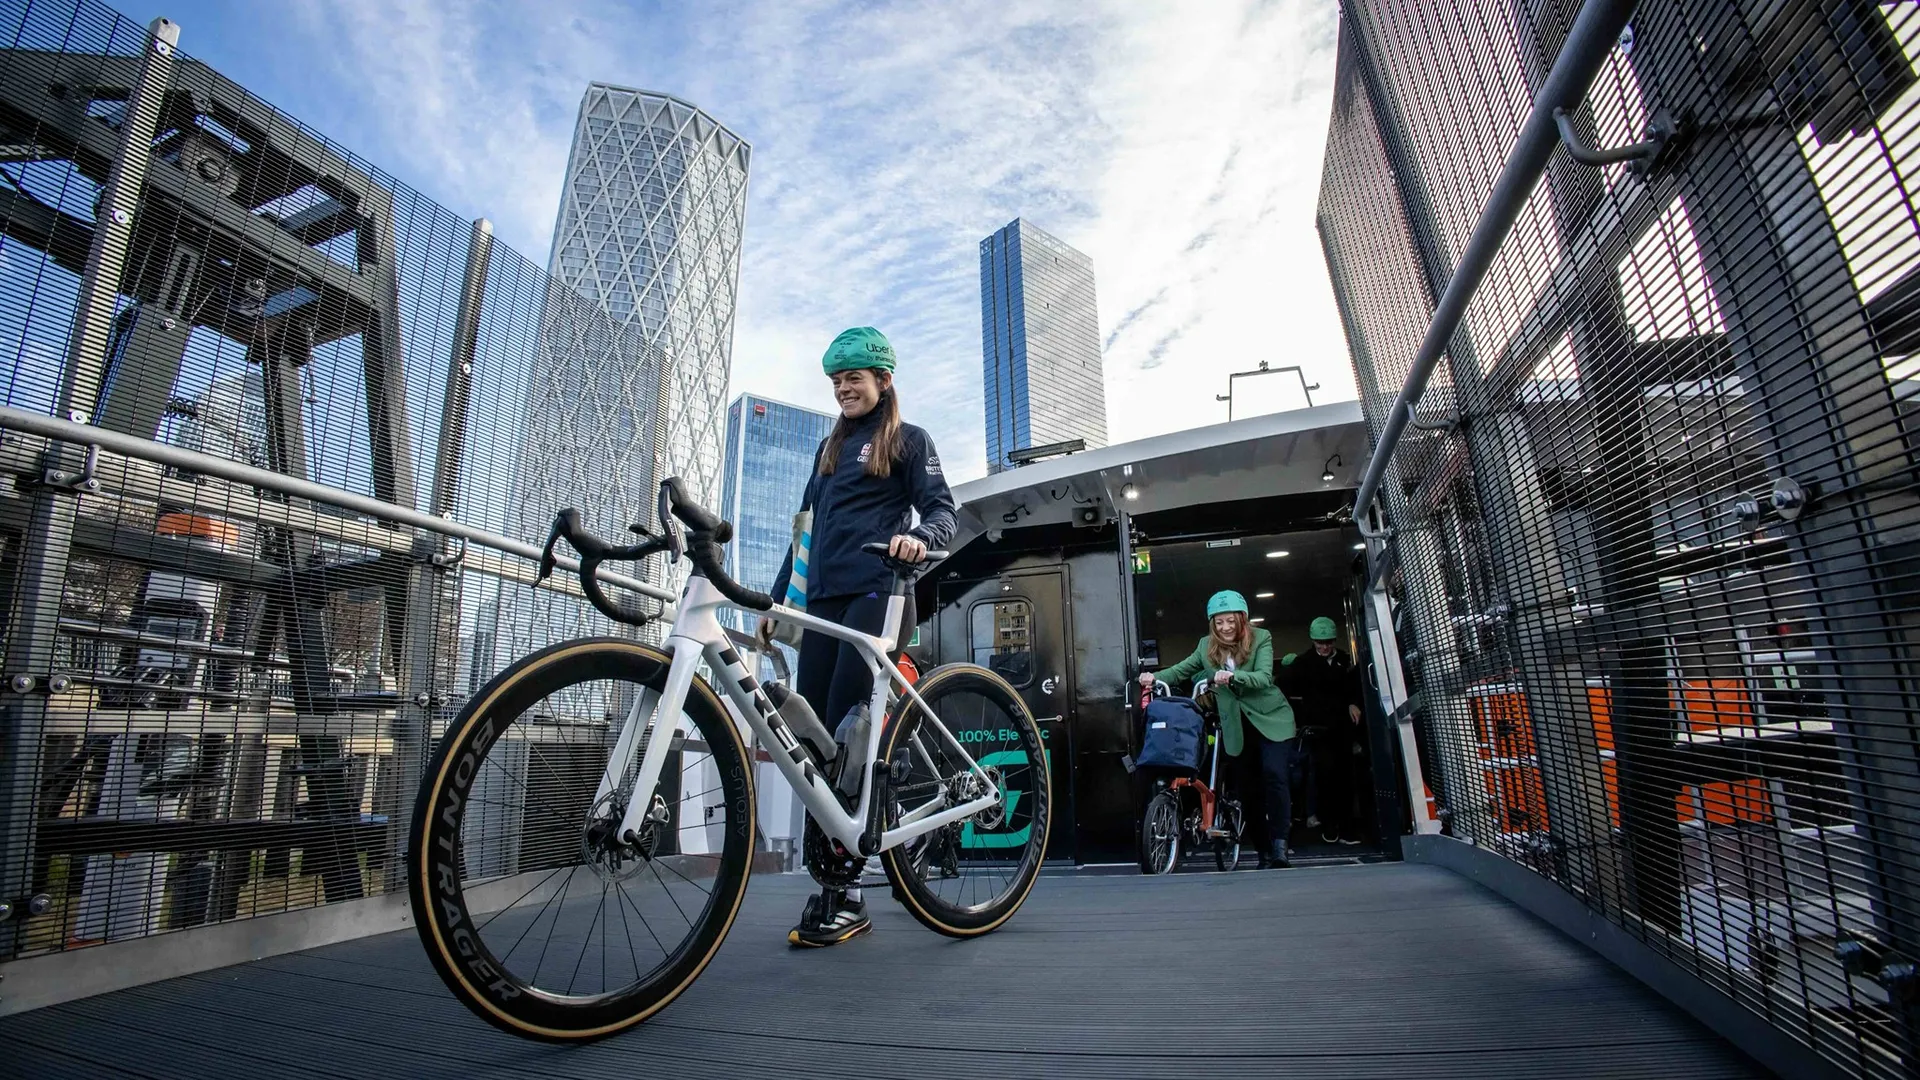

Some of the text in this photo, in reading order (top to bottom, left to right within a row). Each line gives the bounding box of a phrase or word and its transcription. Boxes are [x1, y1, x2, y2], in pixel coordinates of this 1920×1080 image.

[865, 342, 889, 354] Uber
[718, 633, 823, 788] TREK
[959, 728, 1050, 743] 100% Elec
[731, 765, 748, 838] AEOLUS
[1009, 703, 1048, 867] BONTRAGER
[437, 717, 522, 1002] BONTRAGER
